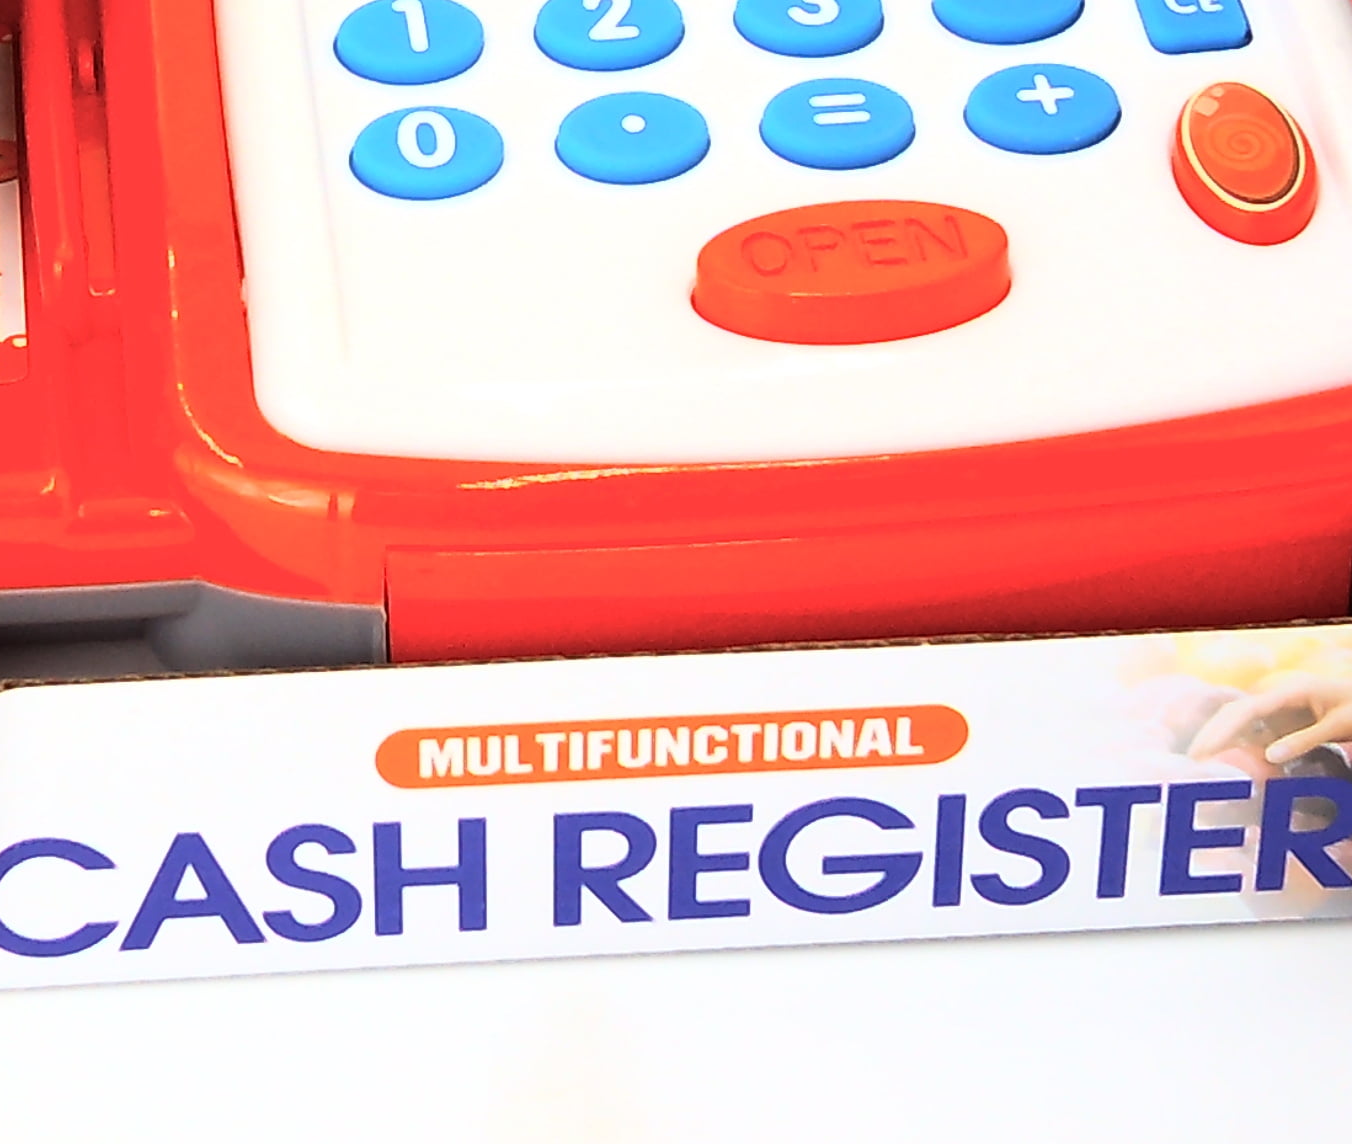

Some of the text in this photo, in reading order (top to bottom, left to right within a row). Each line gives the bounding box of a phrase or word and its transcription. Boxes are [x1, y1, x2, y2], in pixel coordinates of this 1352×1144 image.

[396, 109, 457, 169] 0
[739, 214, 969, 278] OPEN
[417, 716, 925, 780] MULTIFUNCTIONAL
